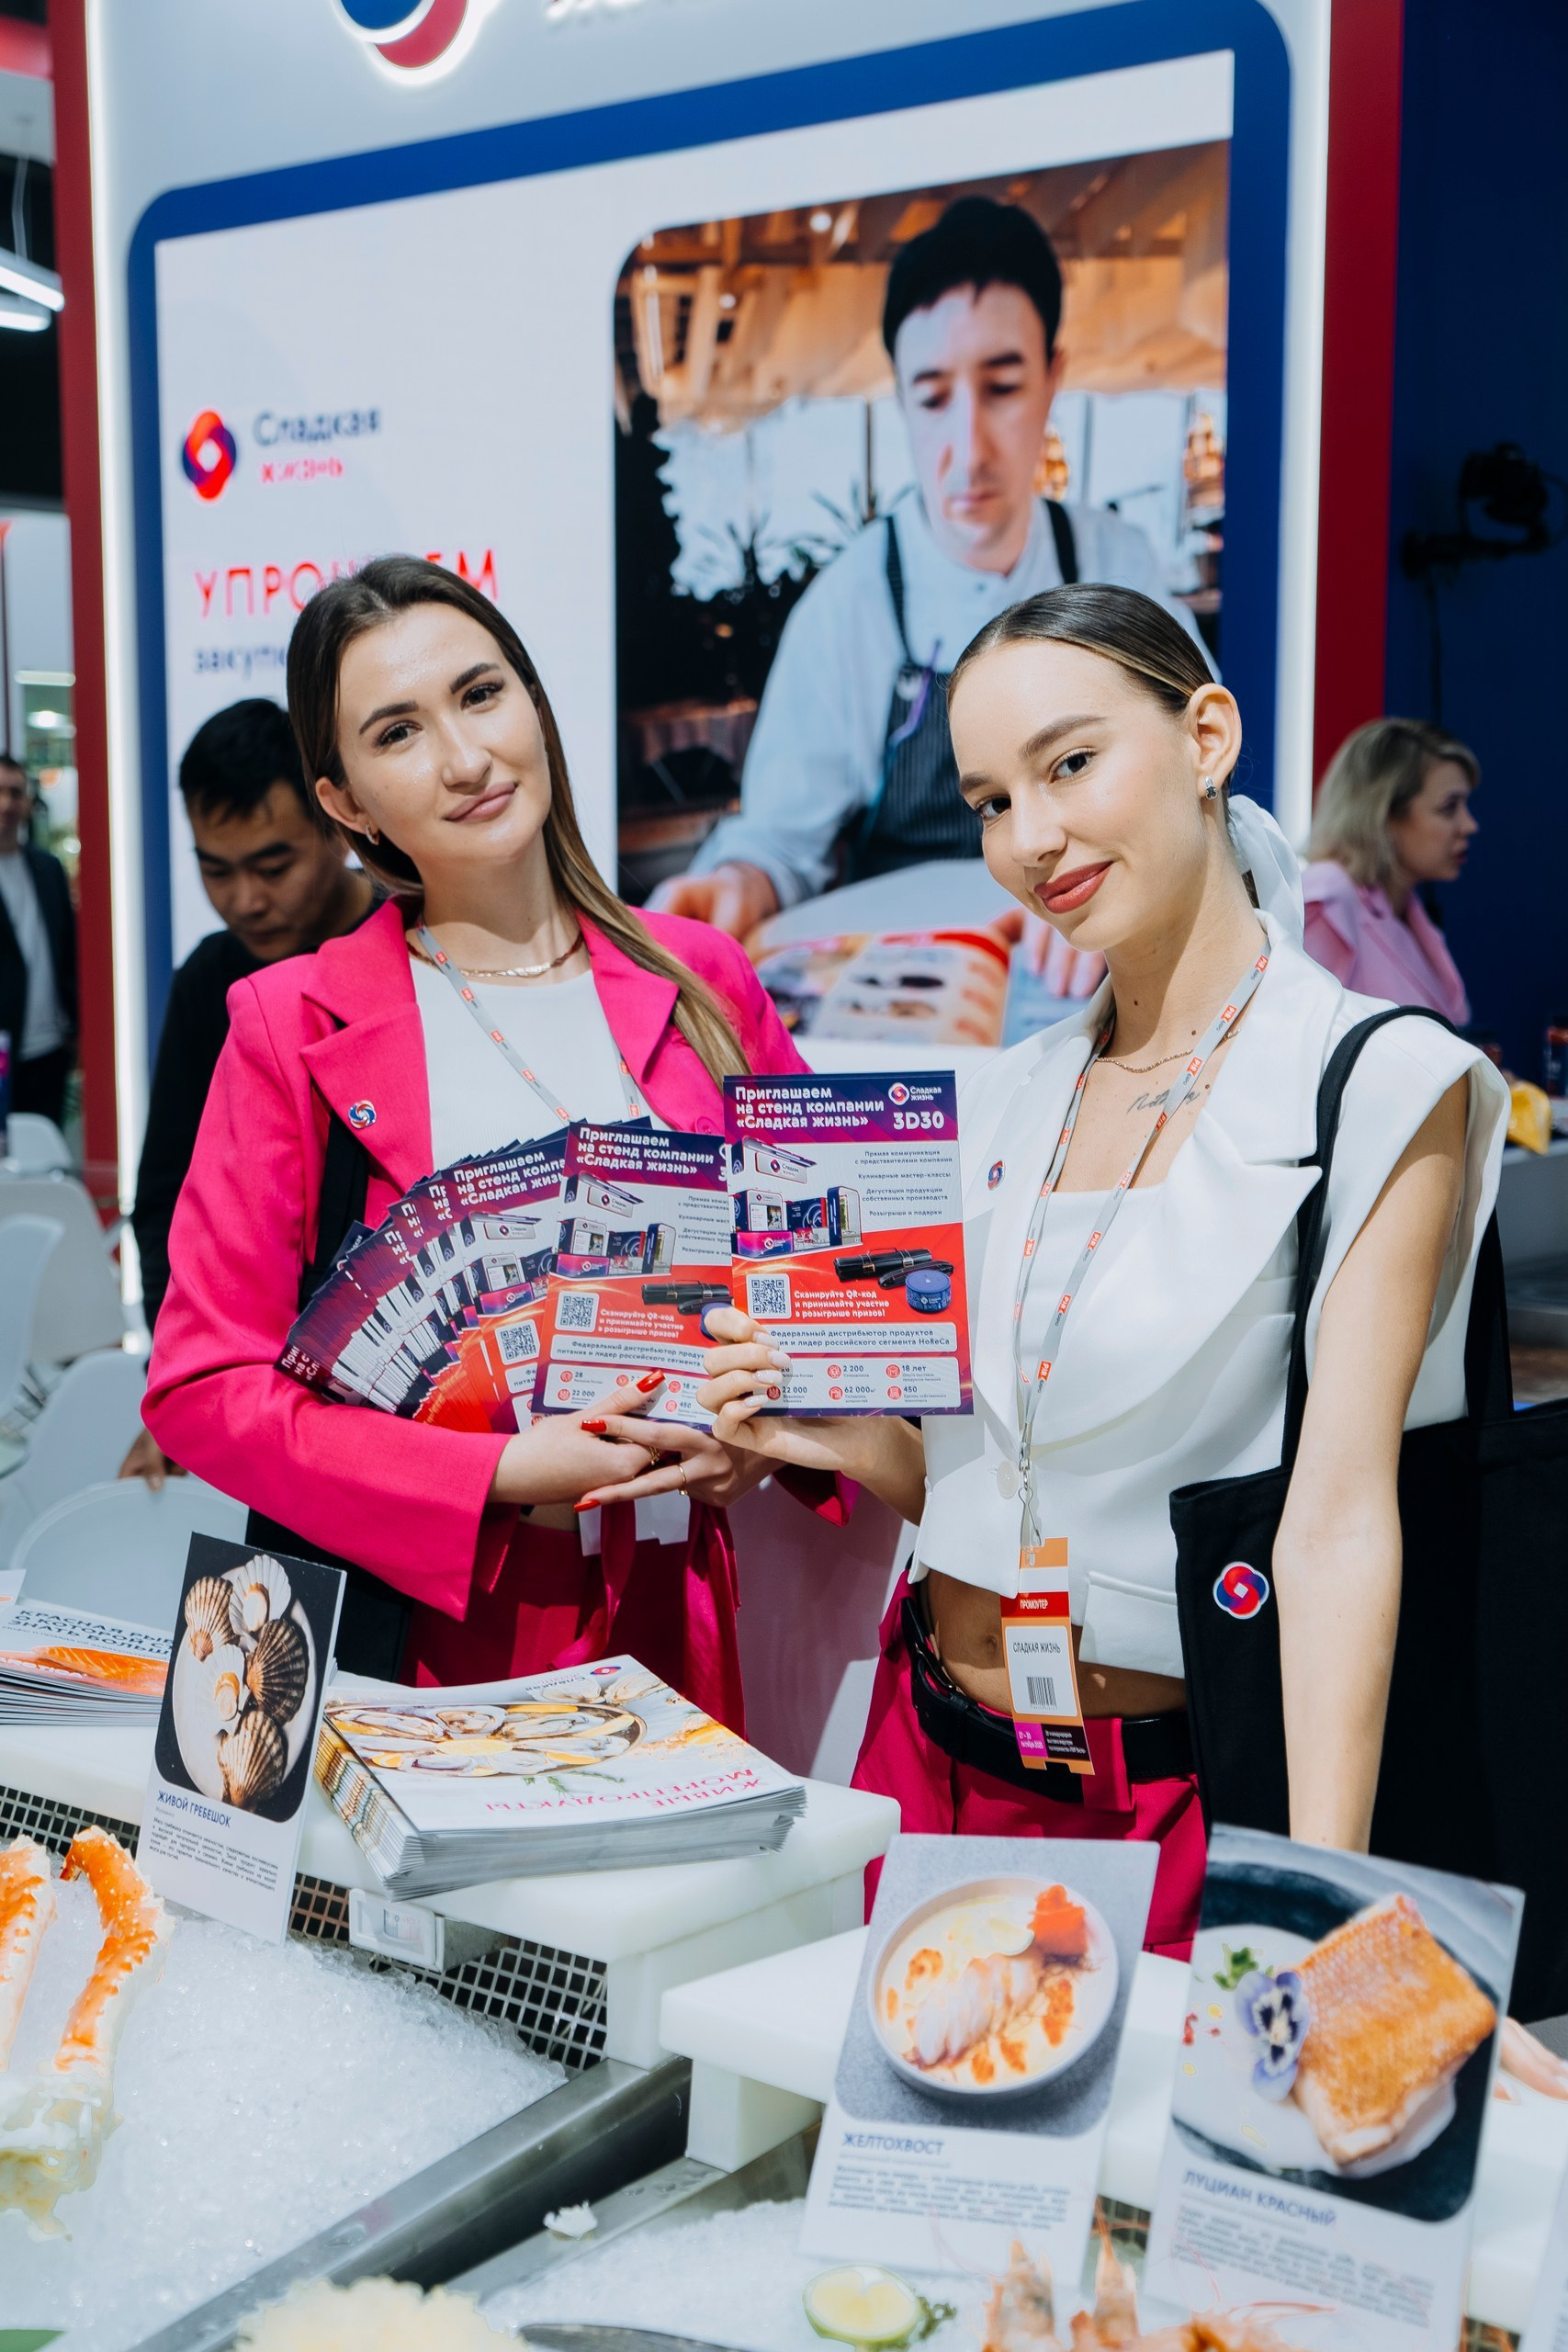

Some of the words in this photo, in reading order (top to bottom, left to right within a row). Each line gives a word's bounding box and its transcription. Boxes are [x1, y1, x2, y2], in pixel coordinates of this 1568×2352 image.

[194, 548, 499, 618] УПРОМ
[1257, 956, 1268, 969] PIR
[1190, 1057, 1201, 1071] PIR
[735, 1086, 832, 1101] Приглашаем
[910, 1086, 942, 1095] Сладкая
[910, 1093, 934, 1102] жизнь
[736, 1102, 754, 1114] на
[758, 1102, 802, 1115] стенд
[807, 1101, 885, 1114] компании
[736, 1114, 807, 1129] «Сладкая
[813, 1114, 869, 1127] жизнь»
[893, 1110, 944, 1130] 3D30
[580, 1127, 670, 1148] Приглашаем
[578, 1143, 594, 1153] на
[599, 1145, 639, 1159] стенд
[643, 1148, 714, 1164] компании
[454, 1151, 546, 1183] Приглашаем
[576, 1154, 643, 1170] «Сладкая
[646, 1161, 698, 1174] жизнь»
[457, 1182, 475, 1195] на
[478, 1171, 521, 1190] стенд
[523, 1159, 565, 1178] компа
[460, 1182, 528, 1206] «Сладкая
[1089, 1233, 1100, 1247] PIR
[794, 1290, 844, 1299] Сканируйте
[846, 1290, 877, 1300] QR-код
[1059, 1295, 1069, 1310] PIR
[802, 1300, 854, 1308] принимайте
[856, 1300, 889, 1308] участие
[600, 1308, 646, 1319] Сканируйте
[647, 1313, 674, 1322] QR-код
[802, 1310, 851, 1319] розыгрыше
[852, 1309, 886, 1318] призов!
[606, 1318, 652, 1328] принимайте
[653, 1322, 684, 1330] участие
[828, 1329, 887, 1338] дистрибьютор
[889, 1329, 933, 1338] продуктов
[571, 1341, 622, 1350] Федеральный
[624, 1345, 677, 1355] дистрибьютор
[797, 1340, 822, 1348] лидер
[825, 1339, 876, 1347] российского
[1040, 1362, 1050, 1376] PIR
[1020, 1599, 1048, 1610] ПРОМОУТЕР
[19, 1610, 123, 1634] КРАСНАЯ
[7, 1620, 81, 1637] ЗНАТЬ
[86, 1634, 172, 1655] БОЛЬШ
[38, 1618, 143, 1645] КОТОРОЙ
[1012, 1643, 1040, 1655] СЛАДКАЯ
[1039, 1643, 1061, 1654] ЖИЗНЬ
[485, 1769, 753, 1812] МОРЕПРОДУКТЫ
[654, 1778, 770, 1807] ЖИВЫЕ
[158, 1791, 188, 1812] ЖИВОЙ
[190, 1804, 231, 1827] ГРЕБЕШОК
[842, 2132, 944, 2155] ЖЕЛТОХВОСТ
[1183, 2170, 1252, 2201] ЛУЦИАН
[1256, 2192, 1337, 2227] КРАСНЫЙ
